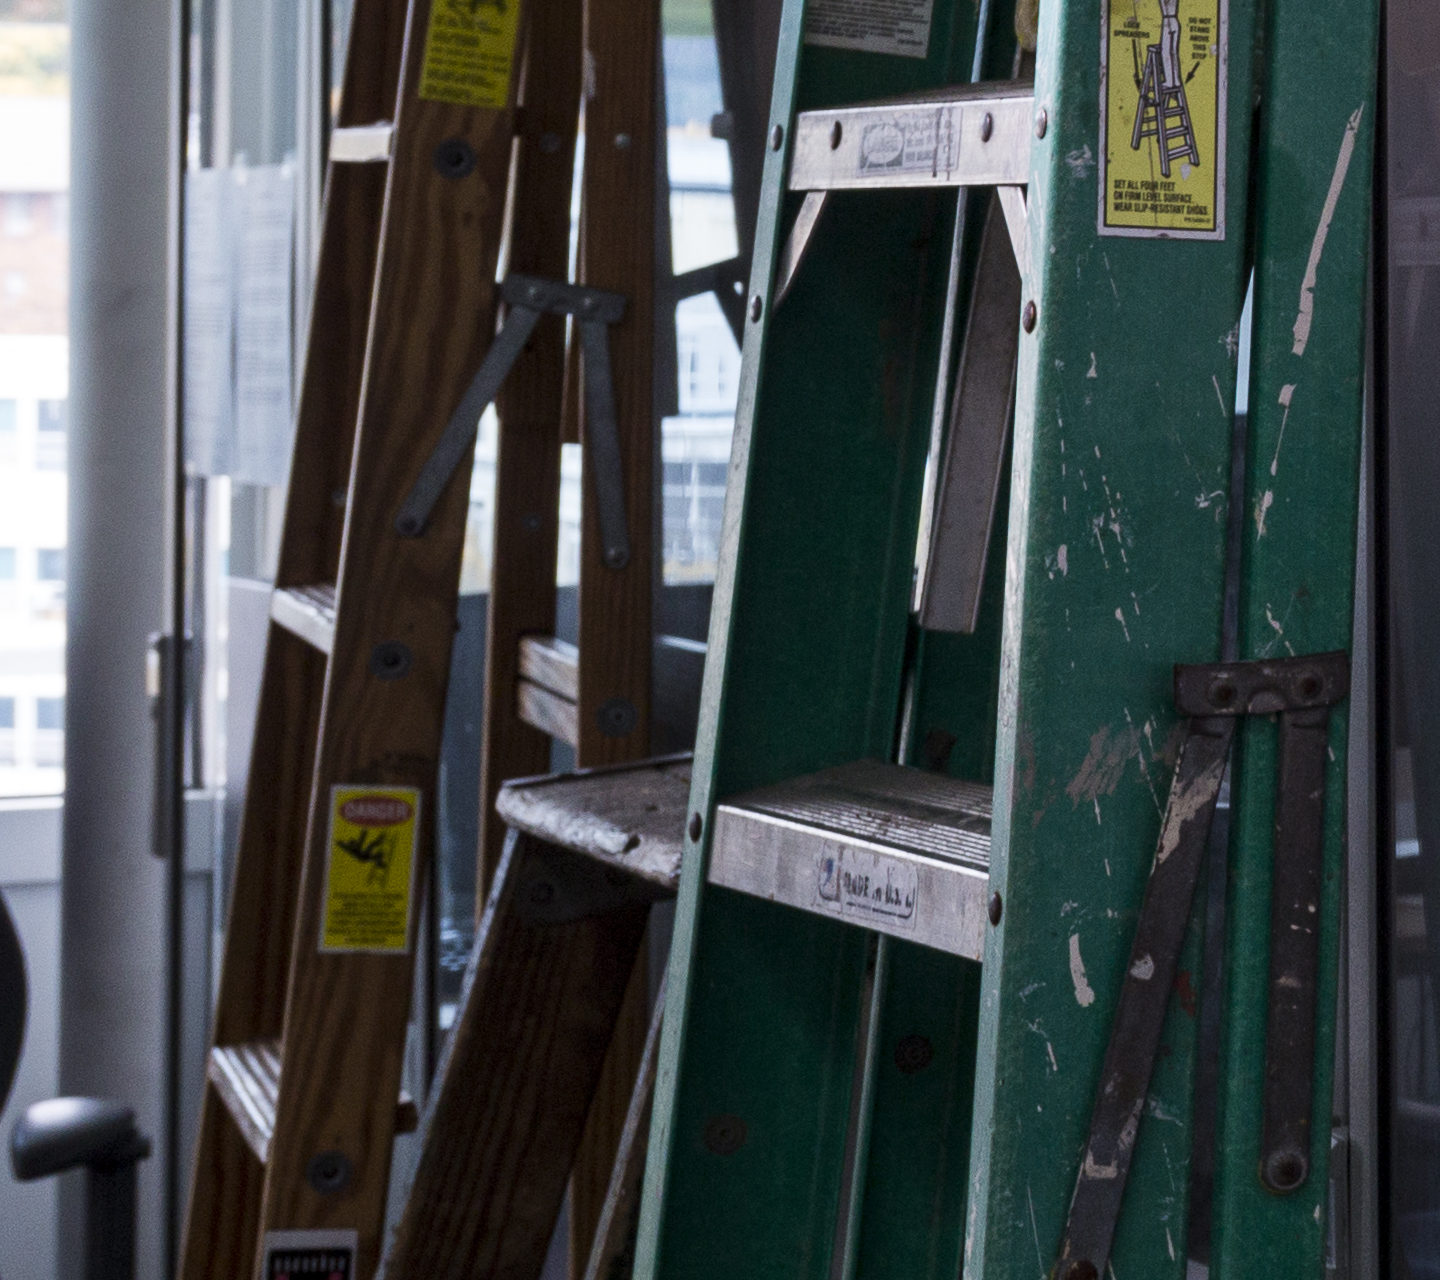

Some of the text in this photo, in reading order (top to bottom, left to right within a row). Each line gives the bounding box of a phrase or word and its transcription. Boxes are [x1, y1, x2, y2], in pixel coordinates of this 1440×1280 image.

[1114, 30, 1150, 38] SPREADERS
[1114, 180, 1175, 191] SET ALL FOUR FEET
[1114, 190, 1123, 200] ON
[1125, 191, 1141, 201] FIRM
[1143, 192, 1161, 201] LEVEL
[1114, 202, 1132, 212] WEAR
[1134, 203, 1184, 214] SLIP-RESISTANT
